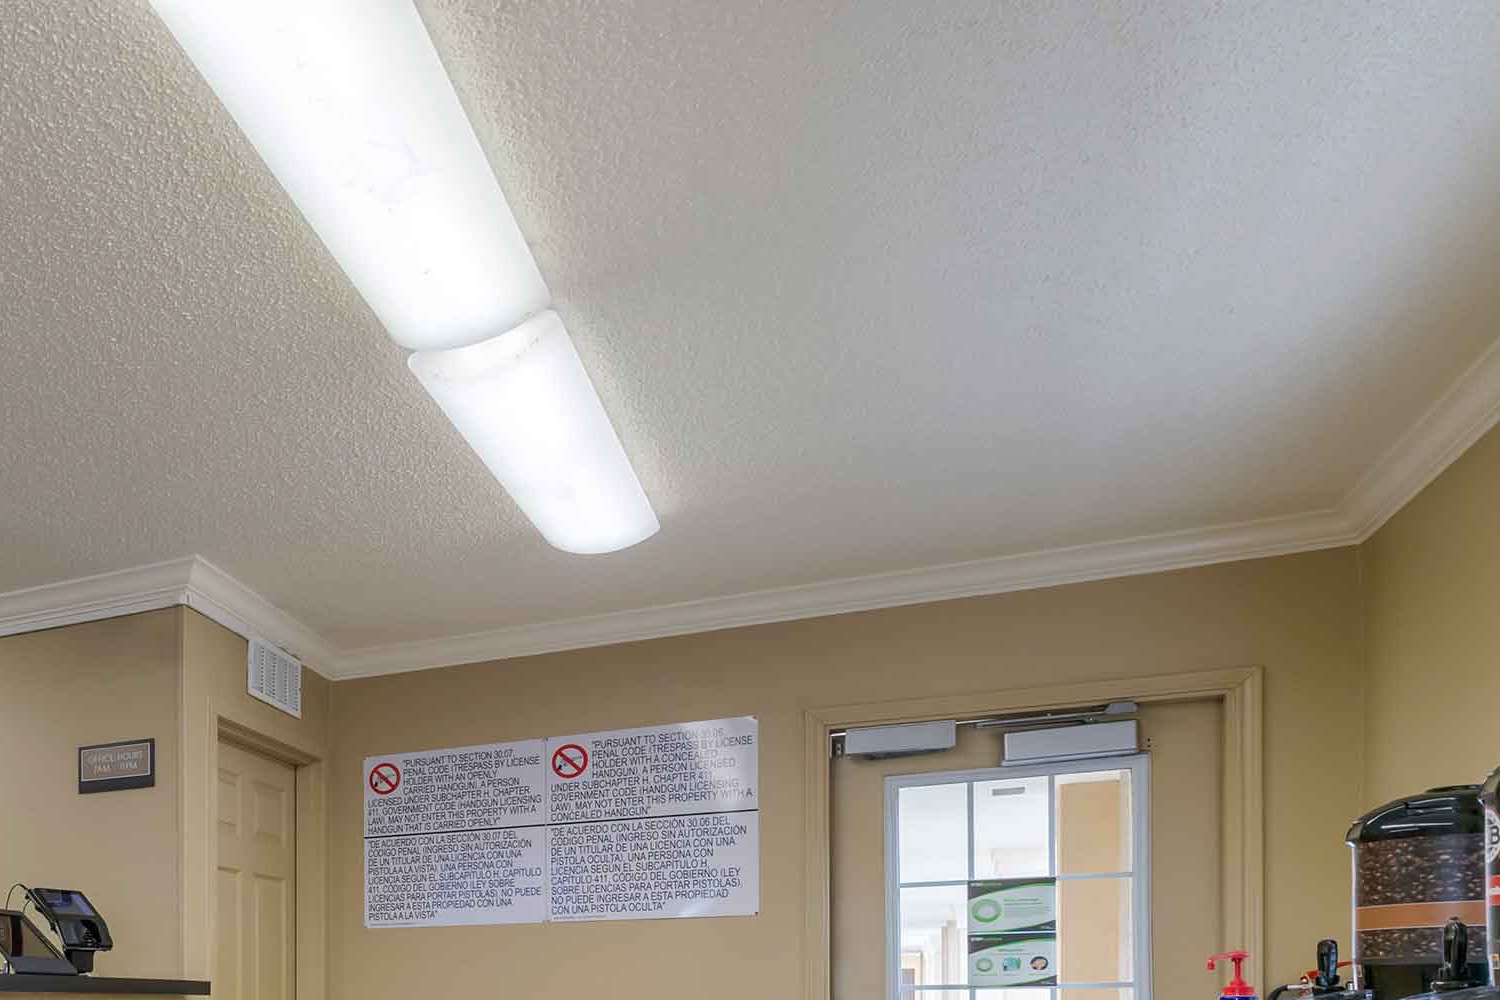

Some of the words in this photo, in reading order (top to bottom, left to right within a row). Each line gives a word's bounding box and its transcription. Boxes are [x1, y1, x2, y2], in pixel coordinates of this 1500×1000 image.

[592, 757, 627, 768] HOLDER
[630, 754, 651, 765] WITH
[650, 762, 687, 774] PERSON
[551, 781, 579, 792] UNDER
[581, 776, 639, 789] SUBCHAPTER
[653, 772, 696, 784] CHAPTER
[551, 789, 610, 801] GOVERNMENT
[612, 787, 636, 797] CODE
[595, 798, 612, 808] NOT
[615, 796, 643, 806] ENTER
[646, 794, 665, 804] THIS
[551, 809, 602, 821] CONCEALED
[566, 824, 608, 835] ACUERDO
[611, 822, 629, 832] CON
[712, 816, 730, 826] DEL
[586, 833, 613, 844] PENAL
[661, 829, 675, 839] SIN
[564, 846, 576, 855] UN
[578, 844, 612, 854] TITULAR
[615, 843, 627, 852] DE
[630, 841, 648, 851] UNA
[650, 839, 691, 850] LICENCIA
[693, 838, 713, 848] CON
[715, 836, 735, 846] UNA
[551, 855, 585, 865] PISTOLA
[628, 852, 646, 861] UNA
[648, 849, 691, 860] PERSONA
[693, 848, 713, 858] CON
[551, 865, 588, 875] LICENCIA
[649, 871, 667, 880] DEL
[669, 868, 717, 879] GOBIERNO
[551, 885, 579, 895] SOBRE
[582, 883, 626, 893] LICENCIAS
[629, 882, 652, 891] PARA
[654, 880, 690, 890] PORTAR
[551, 895, 563, 904] NO
[566, 894, 594, 904] PUEDE
[597, 892, 641, 902] INGRESAR
[650, 891, 672, 900] ESTA
[675, 888, 728, 899] PROPIEDAD
[551, 905, 569, 914] CON
[572, 904, 589, 913] UNA
[591, 903, 627, 913] PISTOLA
